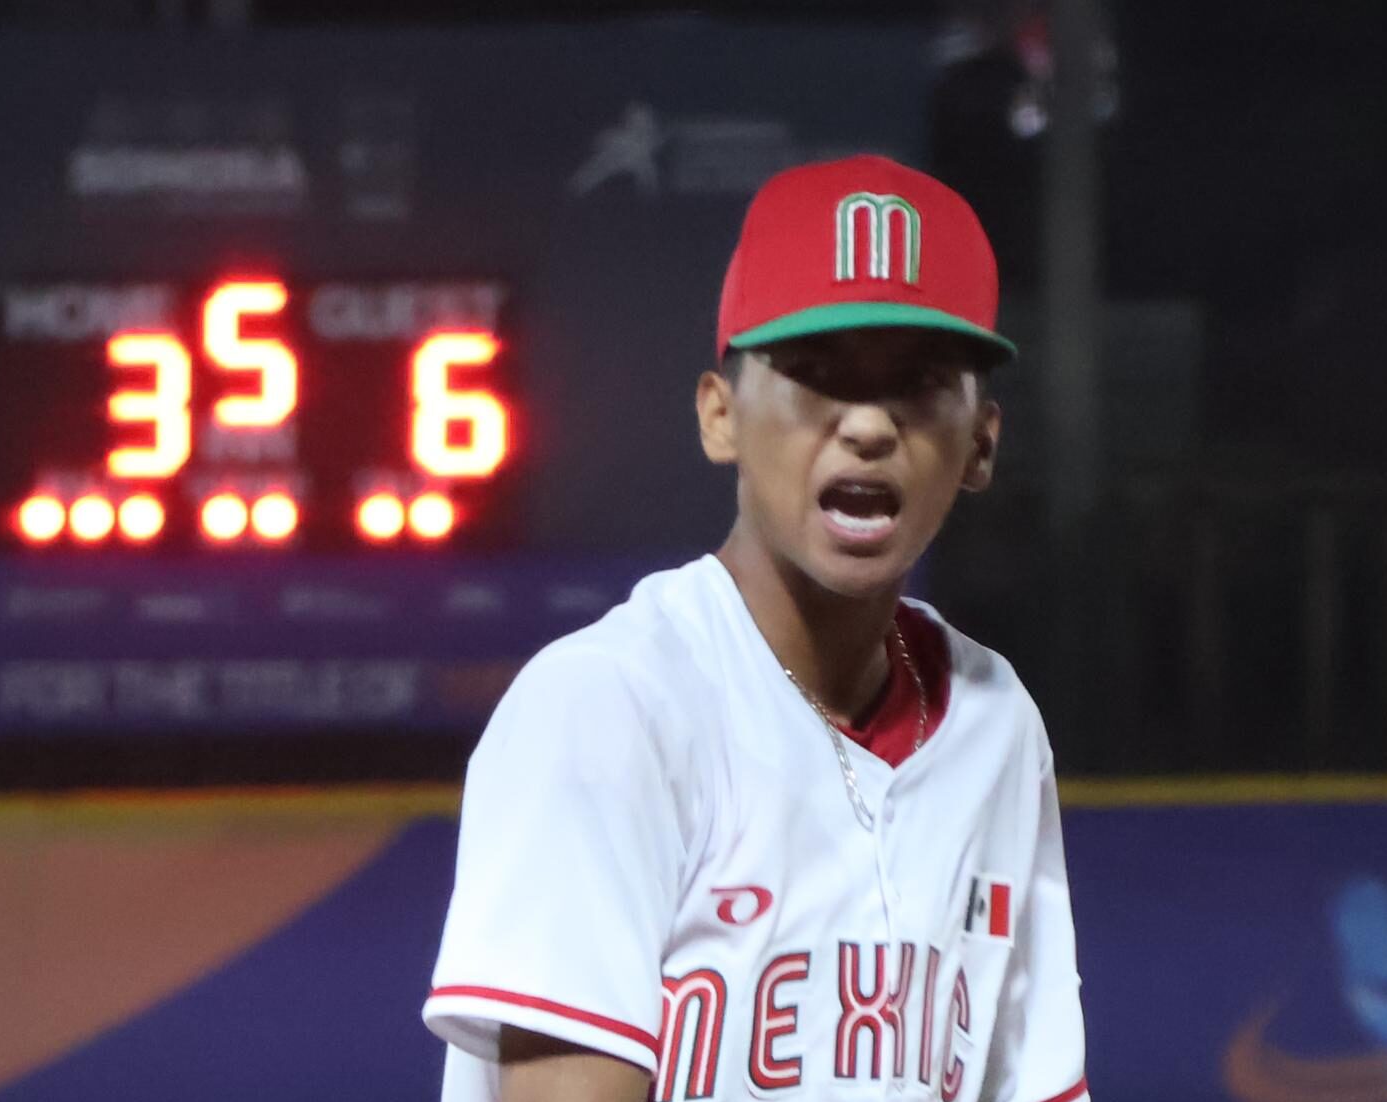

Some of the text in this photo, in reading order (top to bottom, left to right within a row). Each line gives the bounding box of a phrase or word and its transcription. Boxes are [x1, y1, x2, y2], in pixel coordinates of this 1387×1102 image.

[202, 277, 299, 429] 5
[309, 287, 504, 338] GUEST
[105, 331, 192, 480] 3
[410, 330, 509, 480] 6
